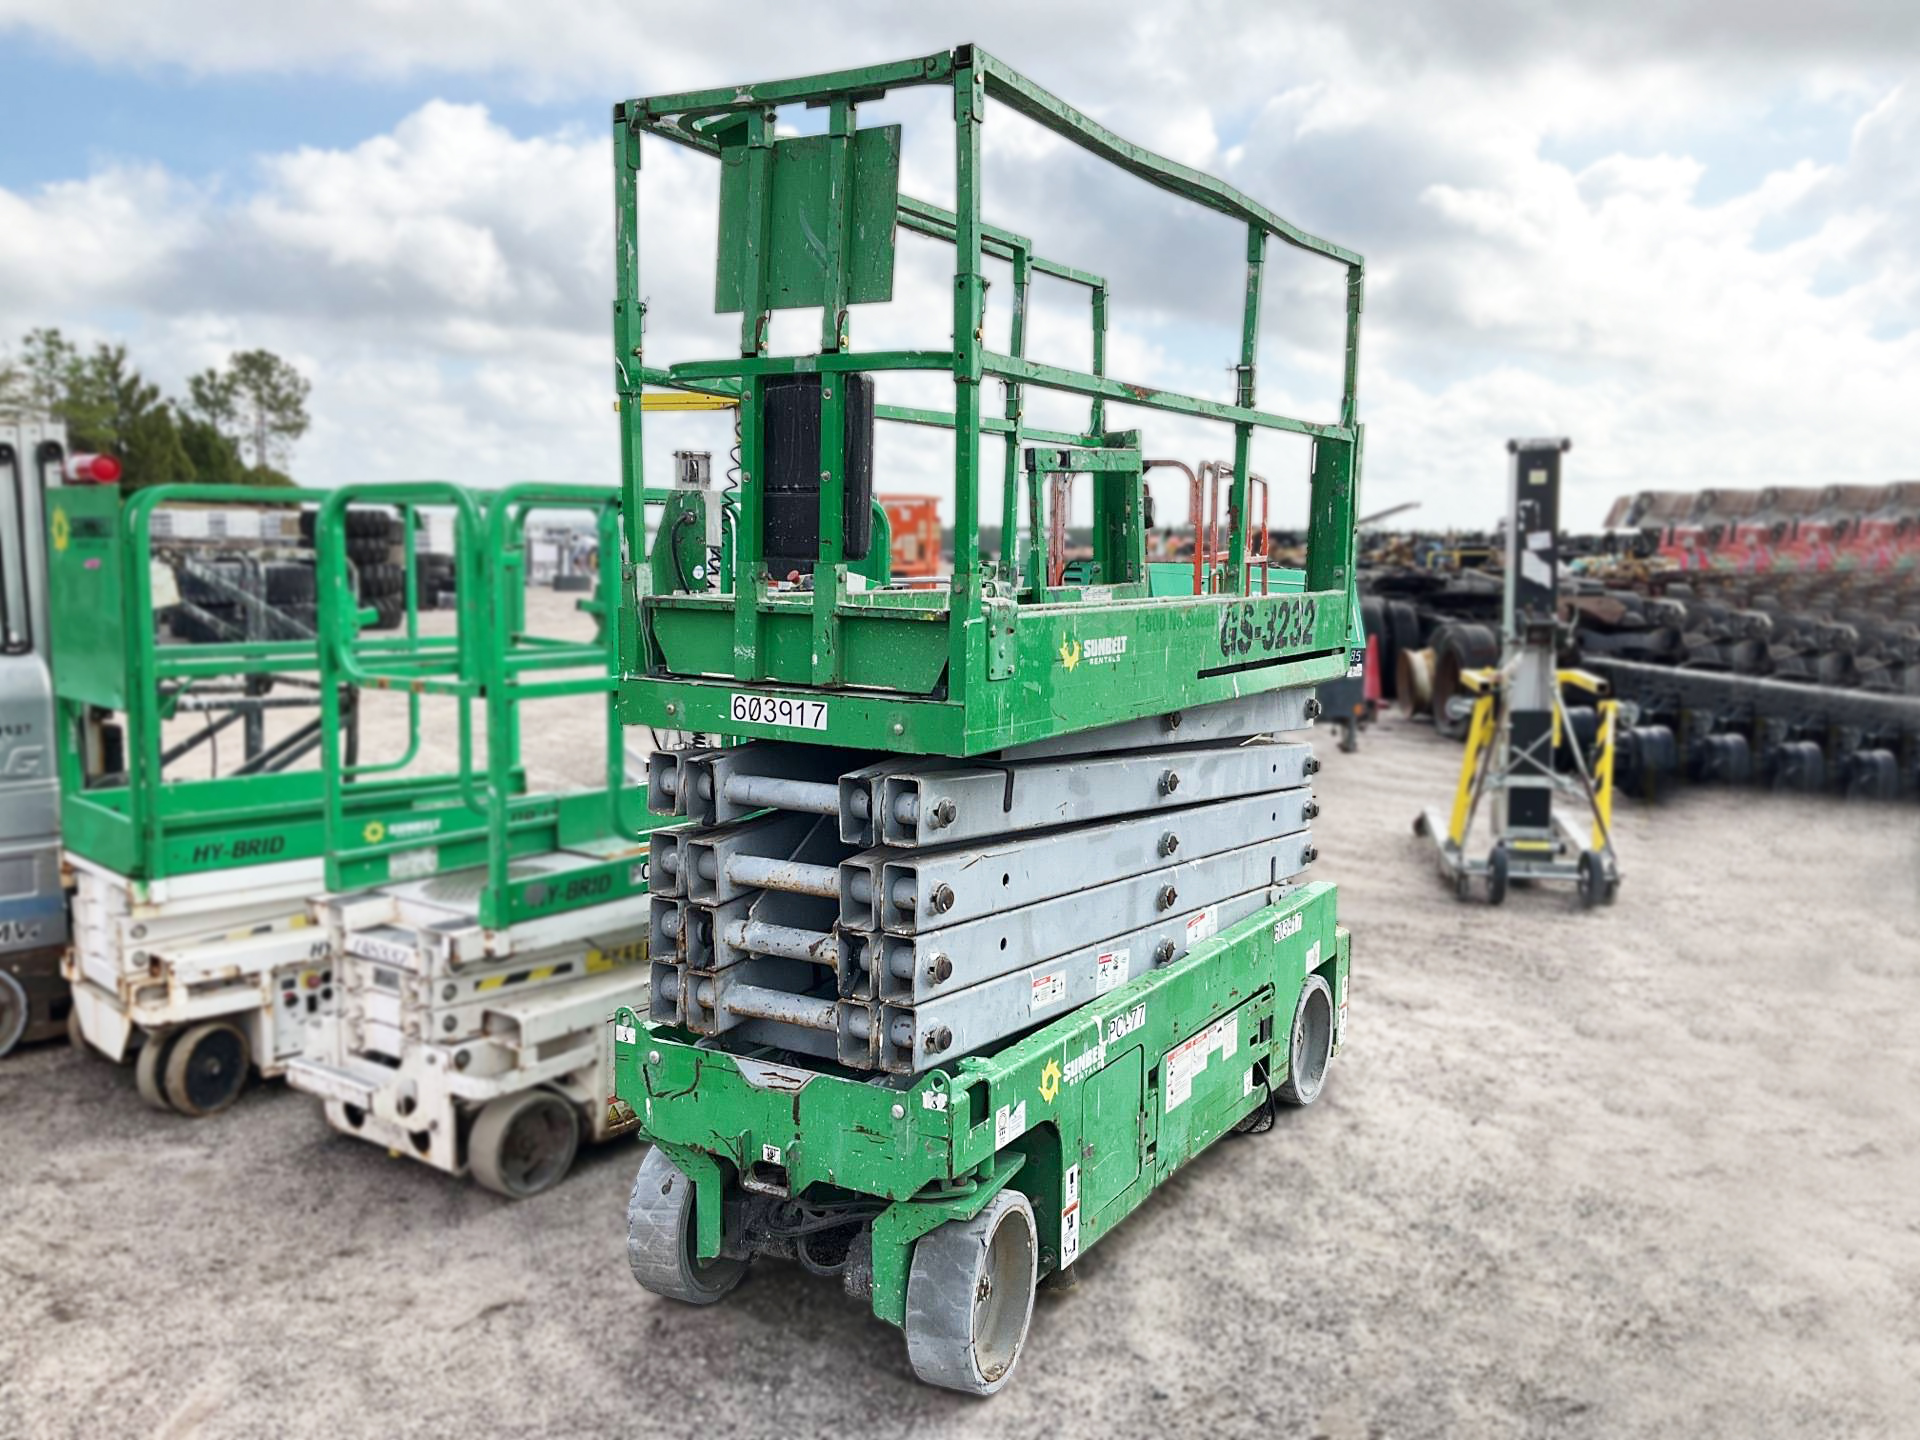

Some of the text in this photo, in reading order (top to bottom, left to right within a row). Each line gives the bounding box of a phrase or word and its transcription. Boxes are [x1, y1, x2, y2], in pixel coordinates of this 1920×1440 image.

[1220, 599, 1315, 656] GS-3232
[1083, 636, 1127, 658] SUNBELT
[1088, 654, 1121, 665] RENTALS
[733, 696, 826, 728] 603917
[193, 835, 286, 864] HY-BRID
[527, 873, 612, 908] Y-BRID
[1109, 1004, 1145, 1041] PC77
